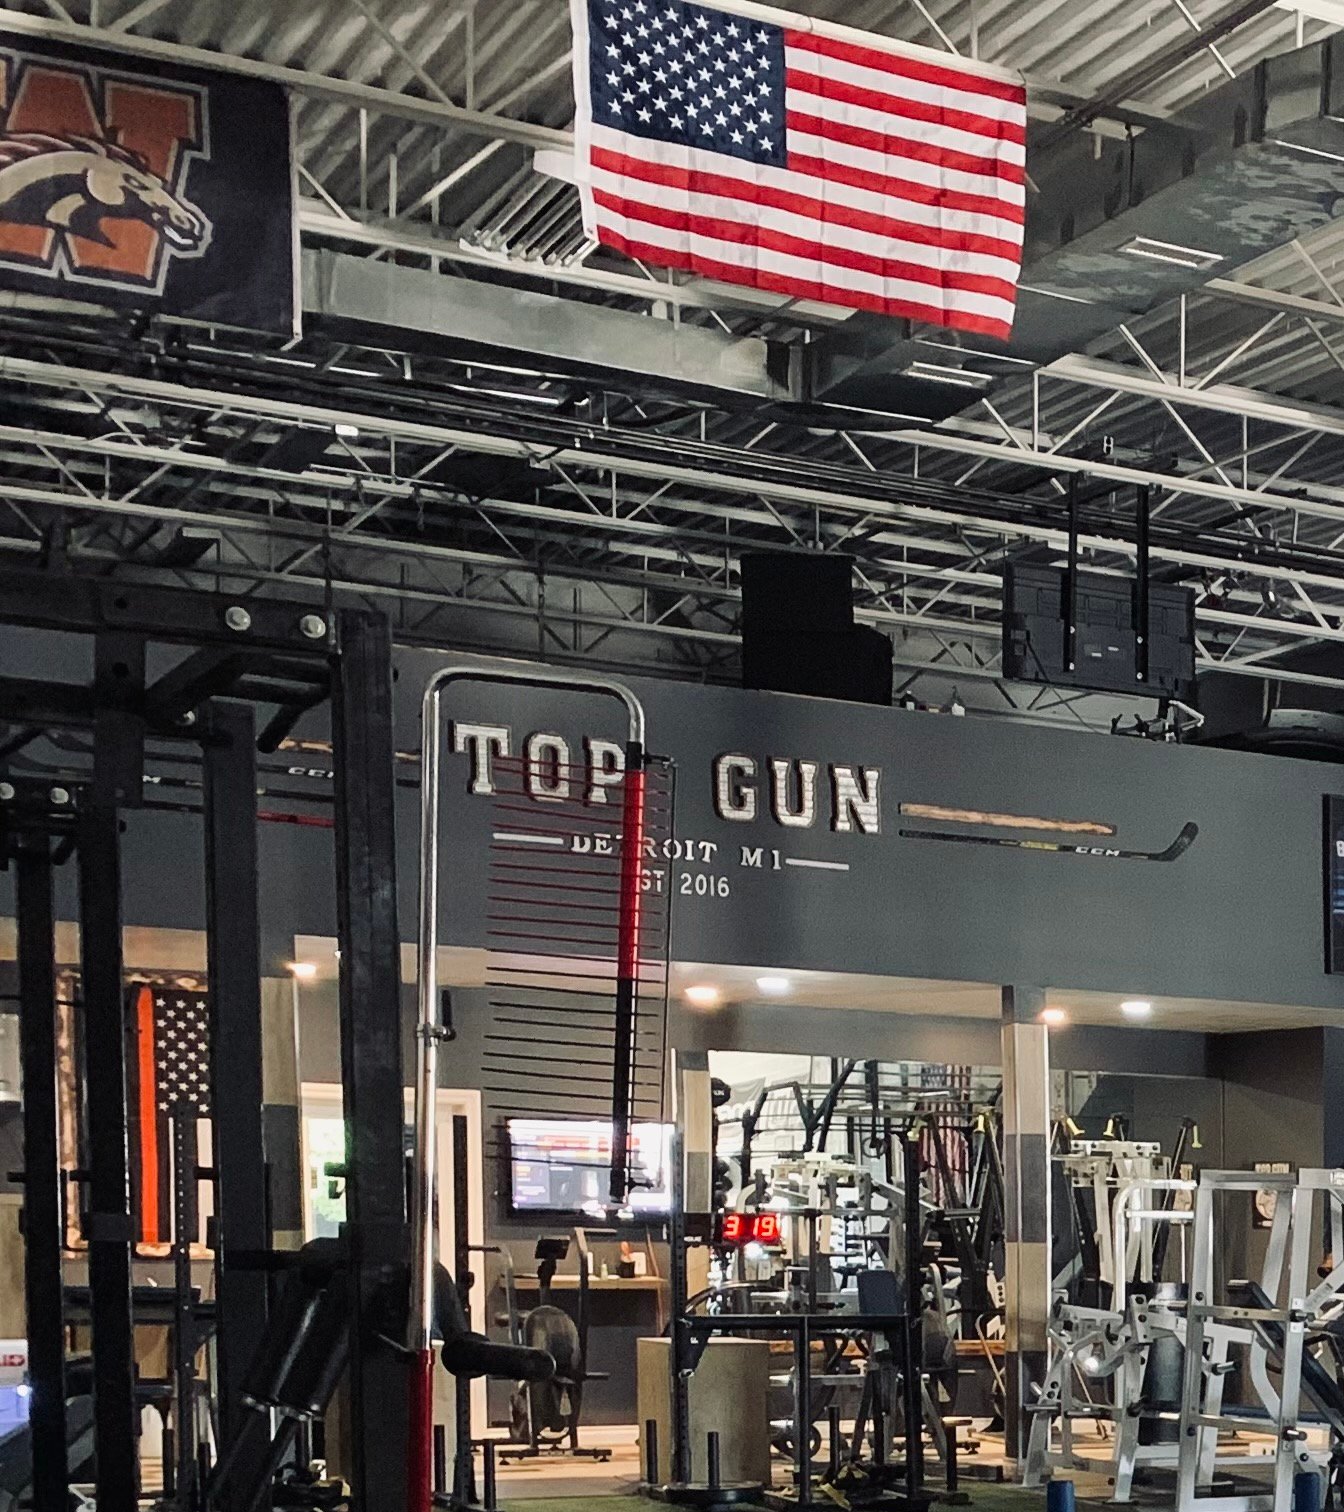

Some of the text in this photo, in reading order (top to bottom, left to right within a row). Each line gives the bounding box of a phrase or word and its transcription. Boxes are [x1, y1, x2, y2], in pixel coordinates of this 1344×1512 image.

[450, 720, 881, 834] TOP GUN
[570, 832, 718, 864] DEROIT
[679, 872, 731, 898] 2016
